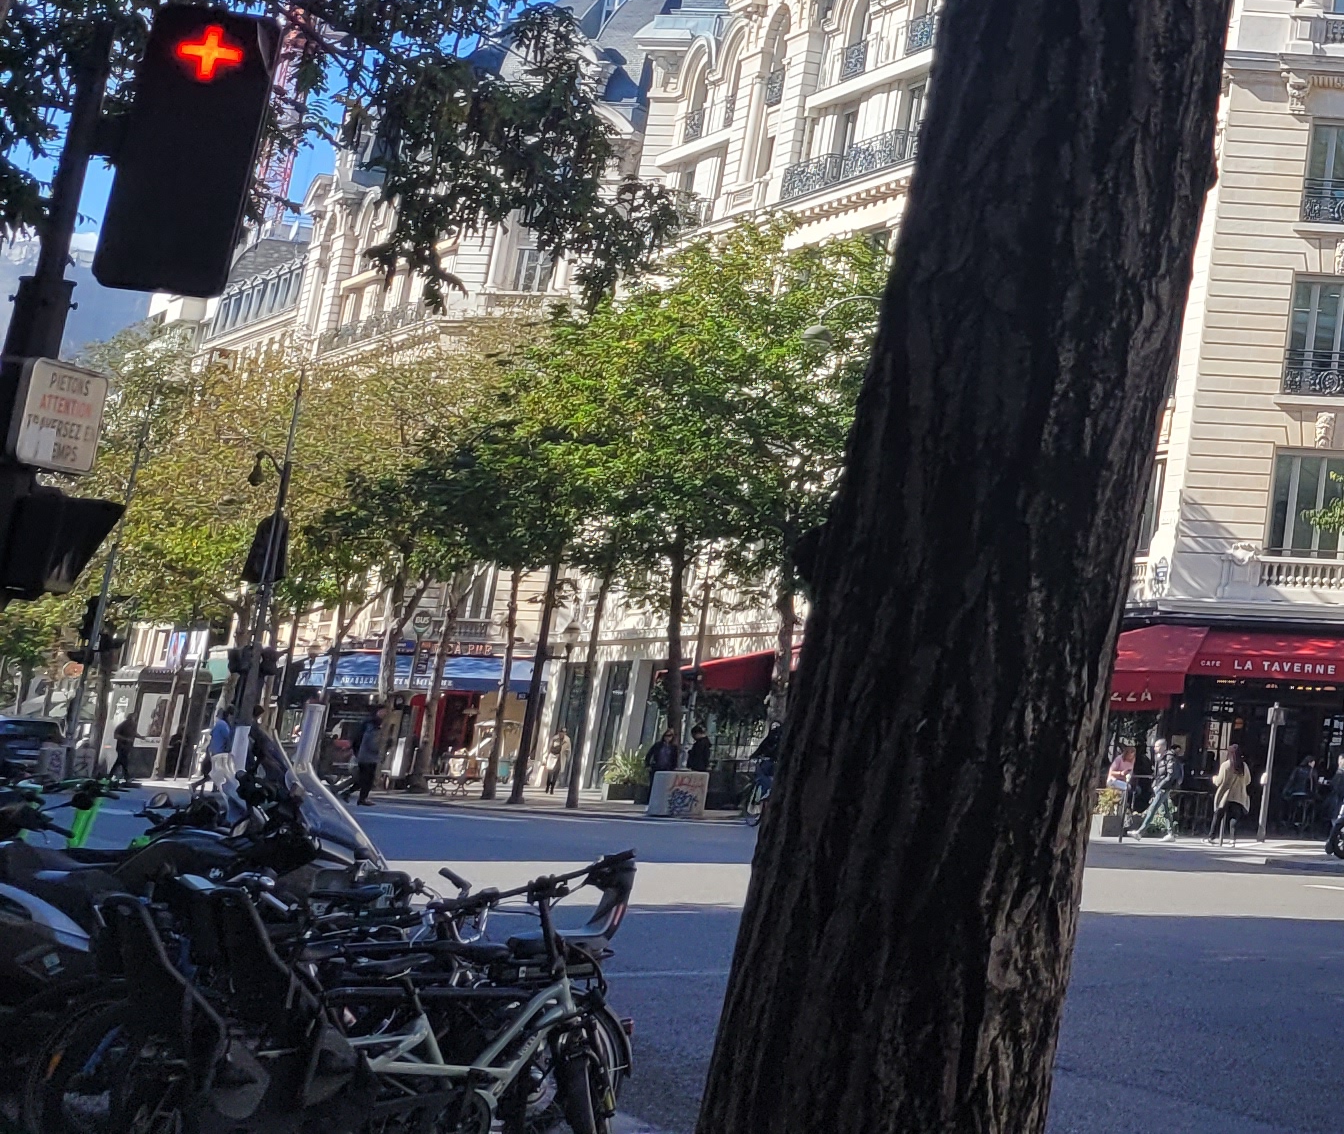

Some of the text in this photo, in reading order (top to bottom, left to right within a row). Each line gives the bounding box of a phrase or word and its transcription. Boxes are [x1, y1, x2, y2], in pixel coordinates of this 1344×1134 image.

[40, 394, 92, 418] ATTENTION
[414, 616, 430, 625] BUS
[1234, 659, 1253, 670] LA
[1262, 661, 1336, 675] TAVERNE
